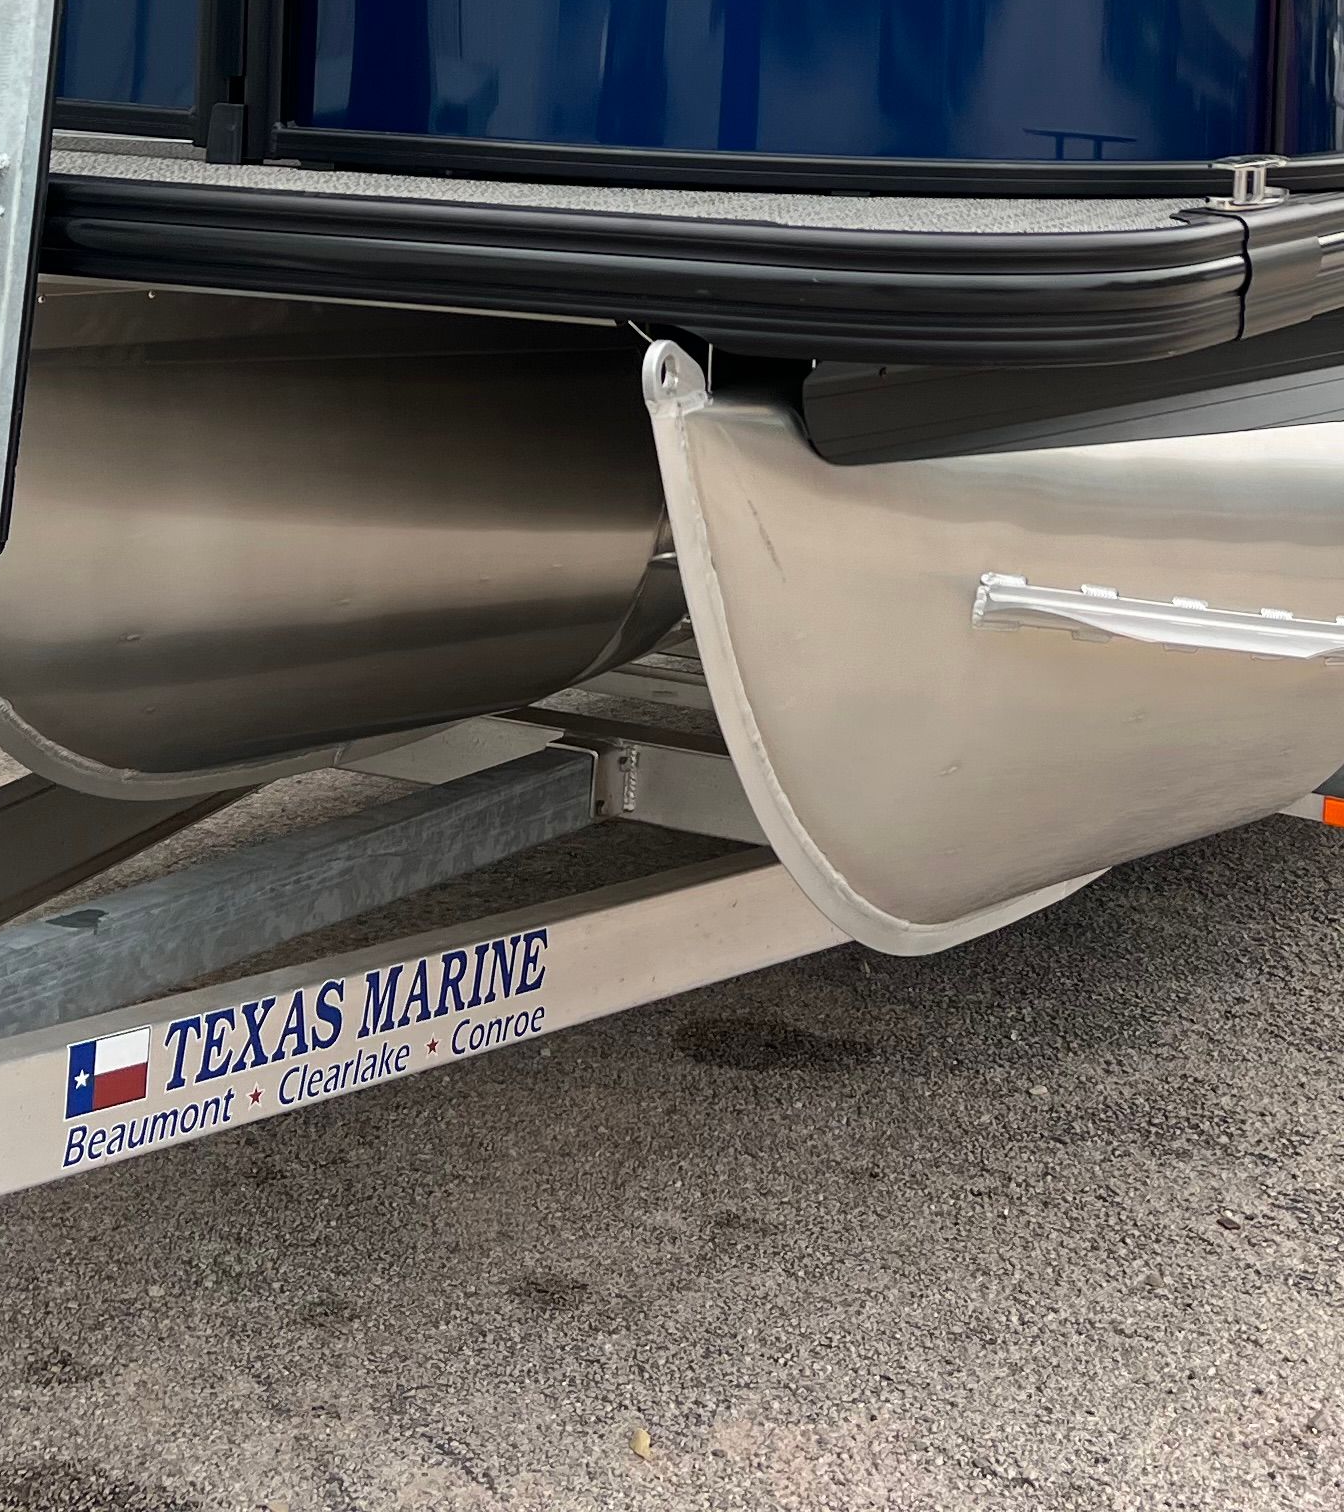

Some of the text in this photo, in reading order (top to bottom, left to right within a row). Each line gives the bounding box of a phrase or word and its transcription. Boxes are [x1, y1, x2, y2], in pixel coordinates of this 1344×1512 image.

[62, 1004, 546, 1168] Beaumont Clearlake Conroe
[164, 928, 548, 1091] TEXAS MARINE
